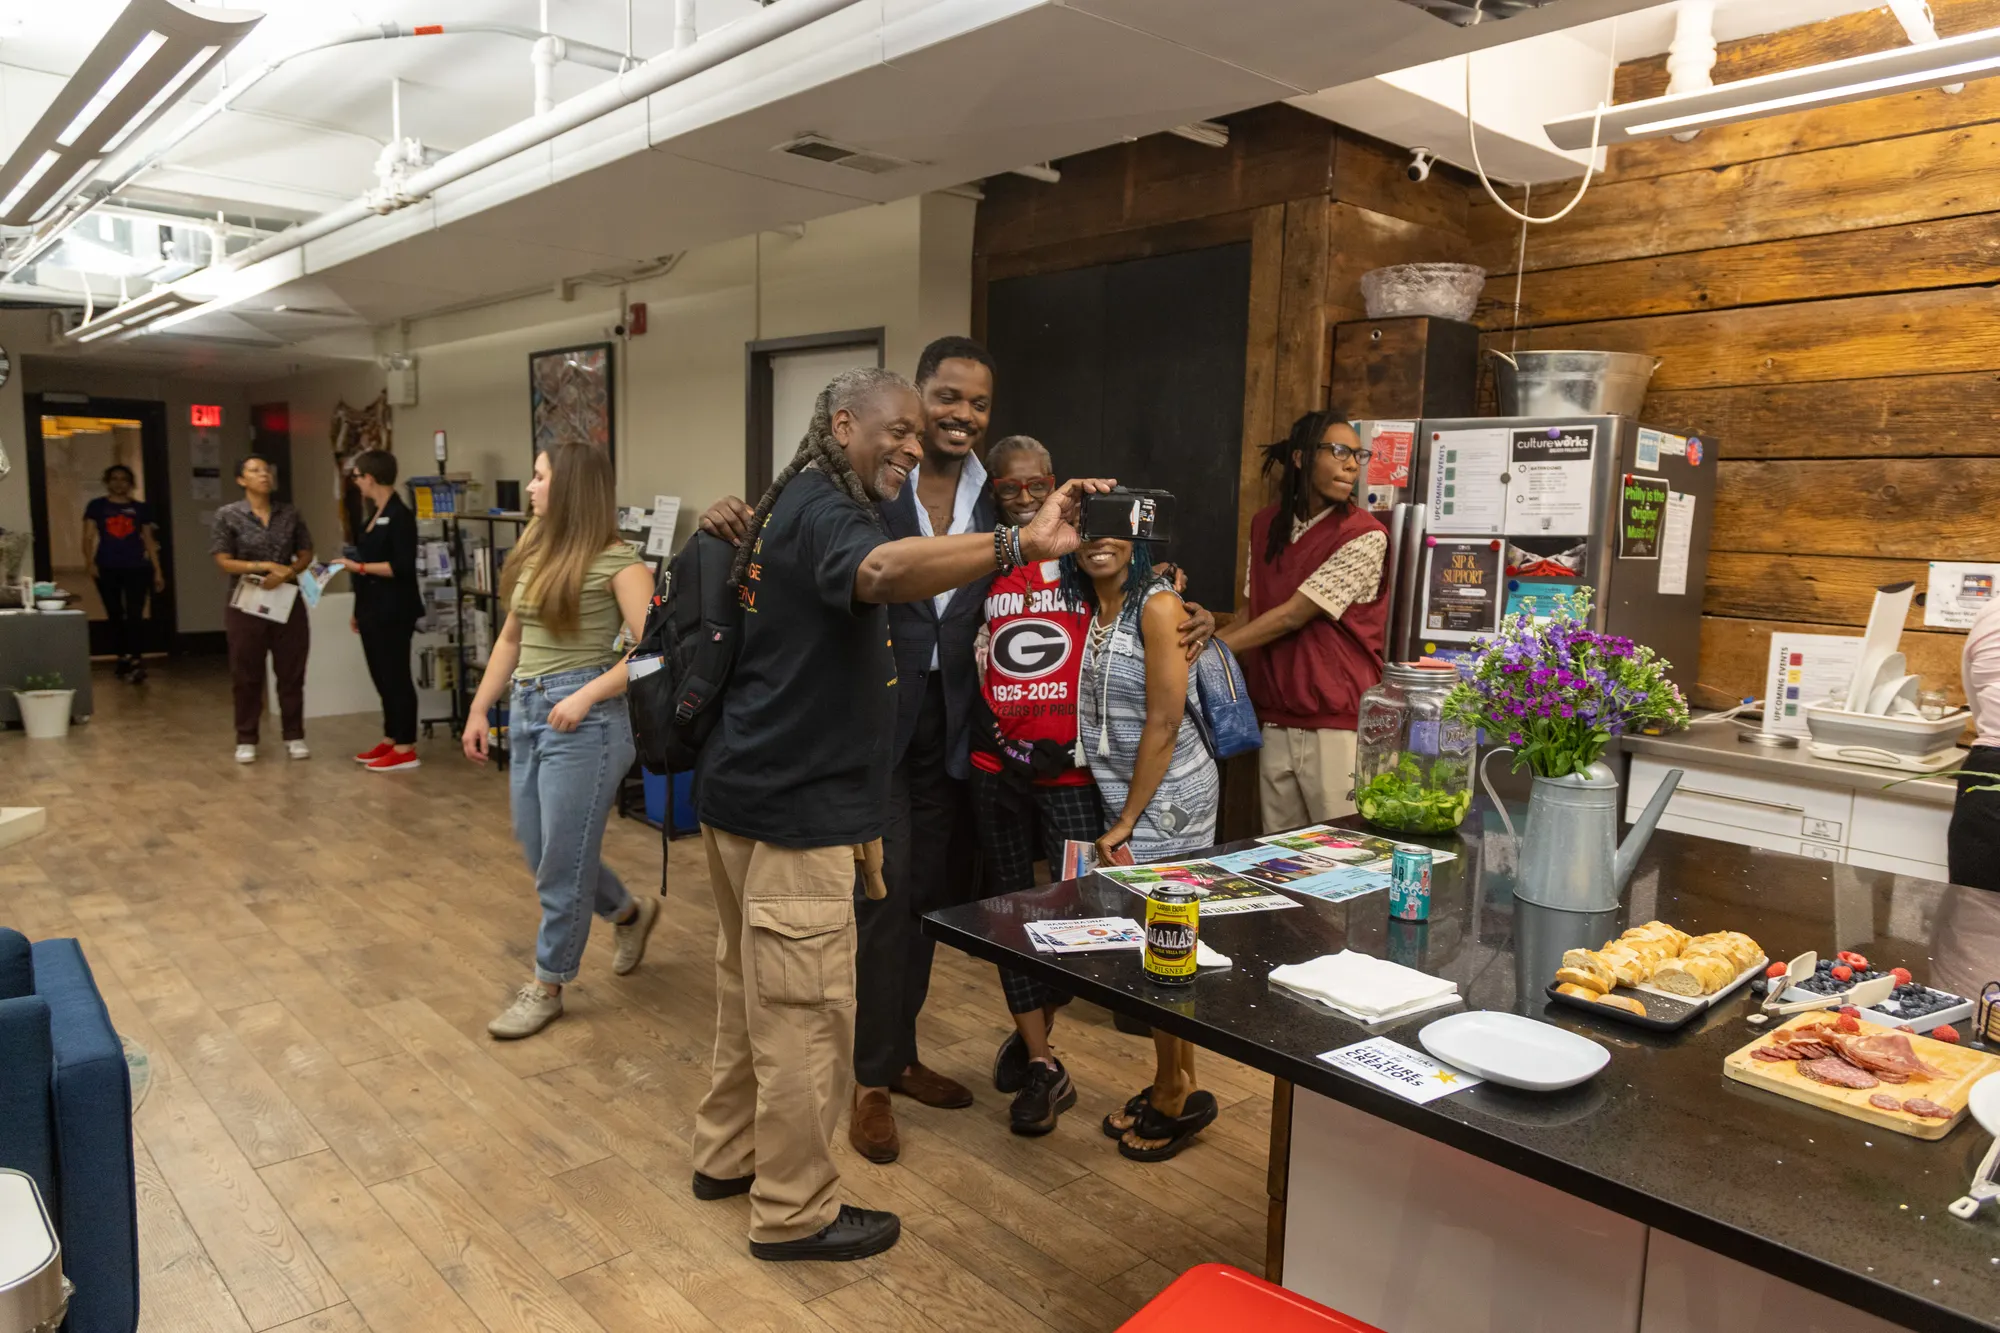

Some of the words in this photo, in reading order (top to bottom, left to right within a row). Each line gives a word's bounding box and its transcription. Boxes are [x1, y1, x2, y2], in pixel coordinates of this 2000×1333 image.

[1437, 444, 1446, 473] EVENTS
[1434, 477, 1444, 521] UPCOMING
[1625, 481, 1647, 504] Philly
[1647, 487, 1654, 502] is
[1654, 488, 1665, 503] the
[1627, 524, 1645, 540] Music
[1452, 554, 1467, 569] SIP
[1467, 555, 1476, 569] &
[1443, 568, 1484, 585] SUPPORT
[1778, 646, 1789, 676] EVENTS
[992, 681, 1068, 702] 1925-2025
[1774, 678, 1785, 721] UPCOMING
[1032, 704, 1046, 716] OF
[1049, 703, 1078, 716] PRID
[1148, 927, 1195, 949] MAMA'S
[1154, 965, 1184, 975] PILSNER
[1345, 1051, 1424, 1087] CREATORS
[1354, 1048, 1424, 1079] CULTURE
